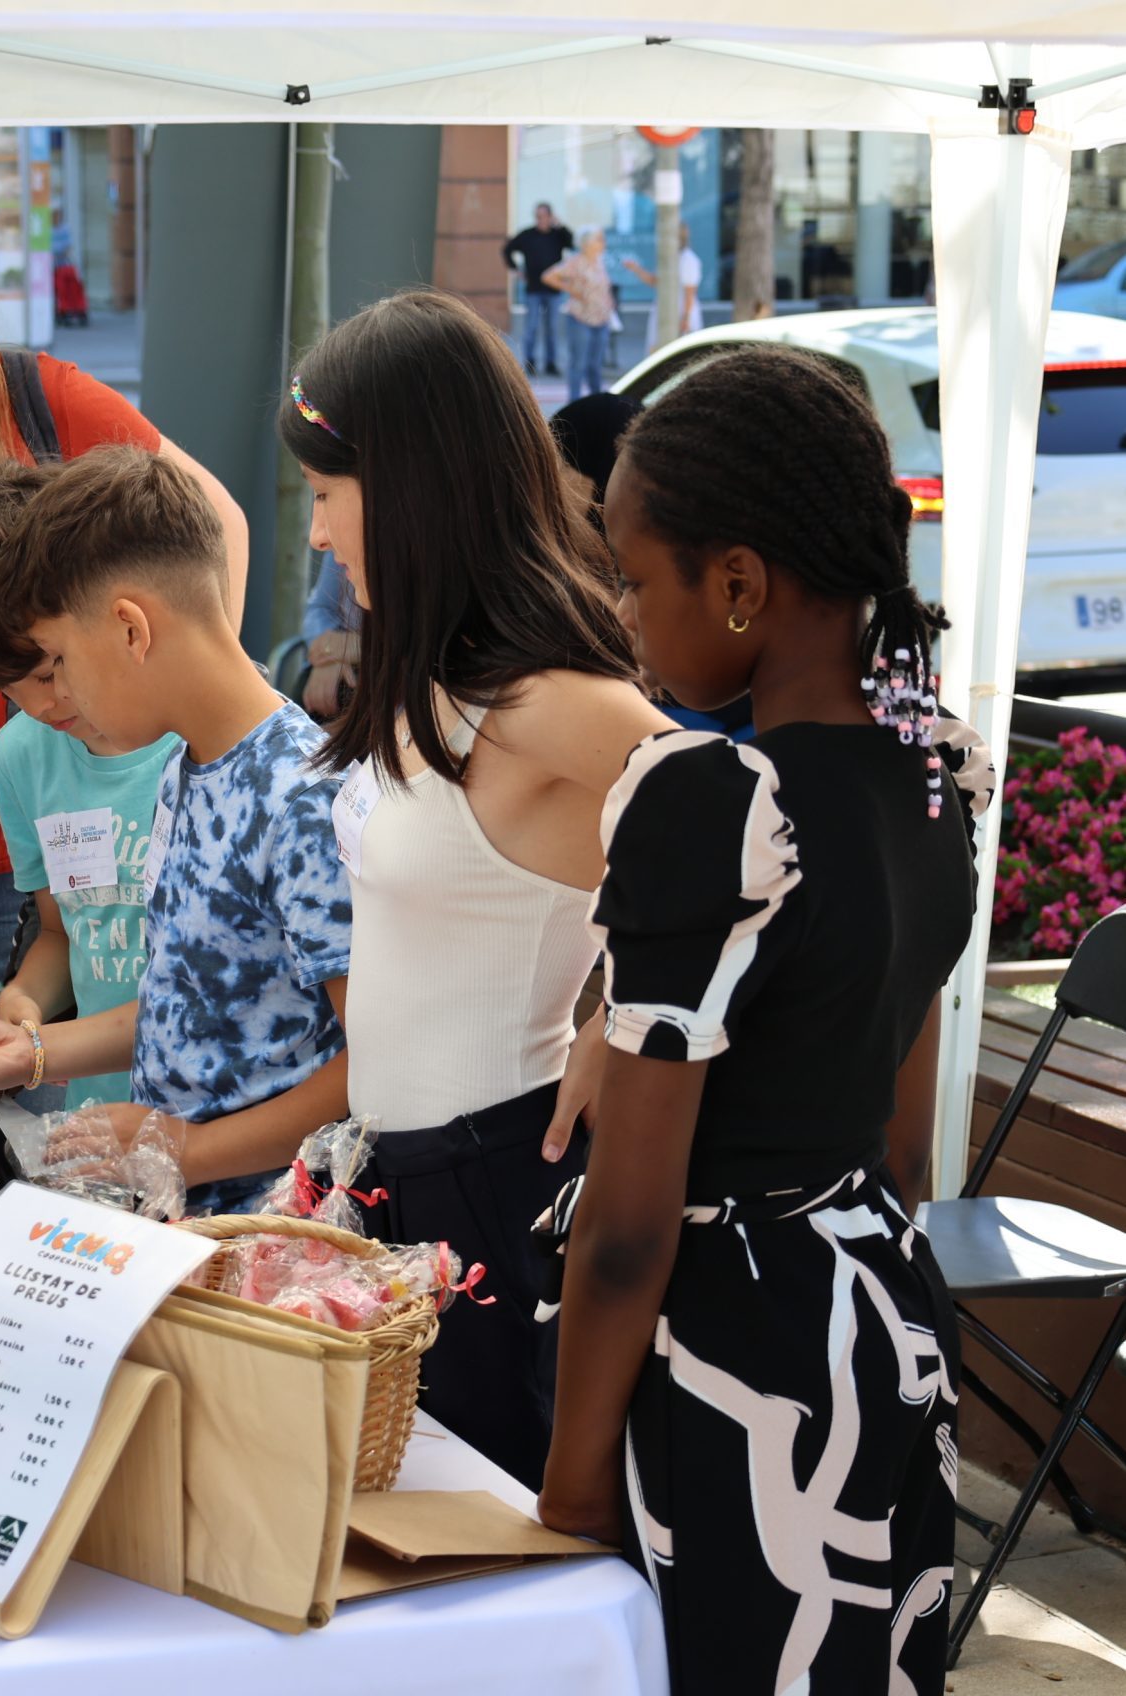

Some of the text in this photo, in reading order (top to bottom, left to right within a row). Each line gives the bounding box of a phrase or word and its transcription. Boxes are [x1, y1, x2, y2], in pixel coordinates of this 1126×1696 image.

[37, 1250, 99, 1273] COOPERATIVA
[3, 1261, 102, 1299] LLISTAT DE
[13, 1283, 69, 1309] PREUS
[0, 1339, 25, 1352] resina
